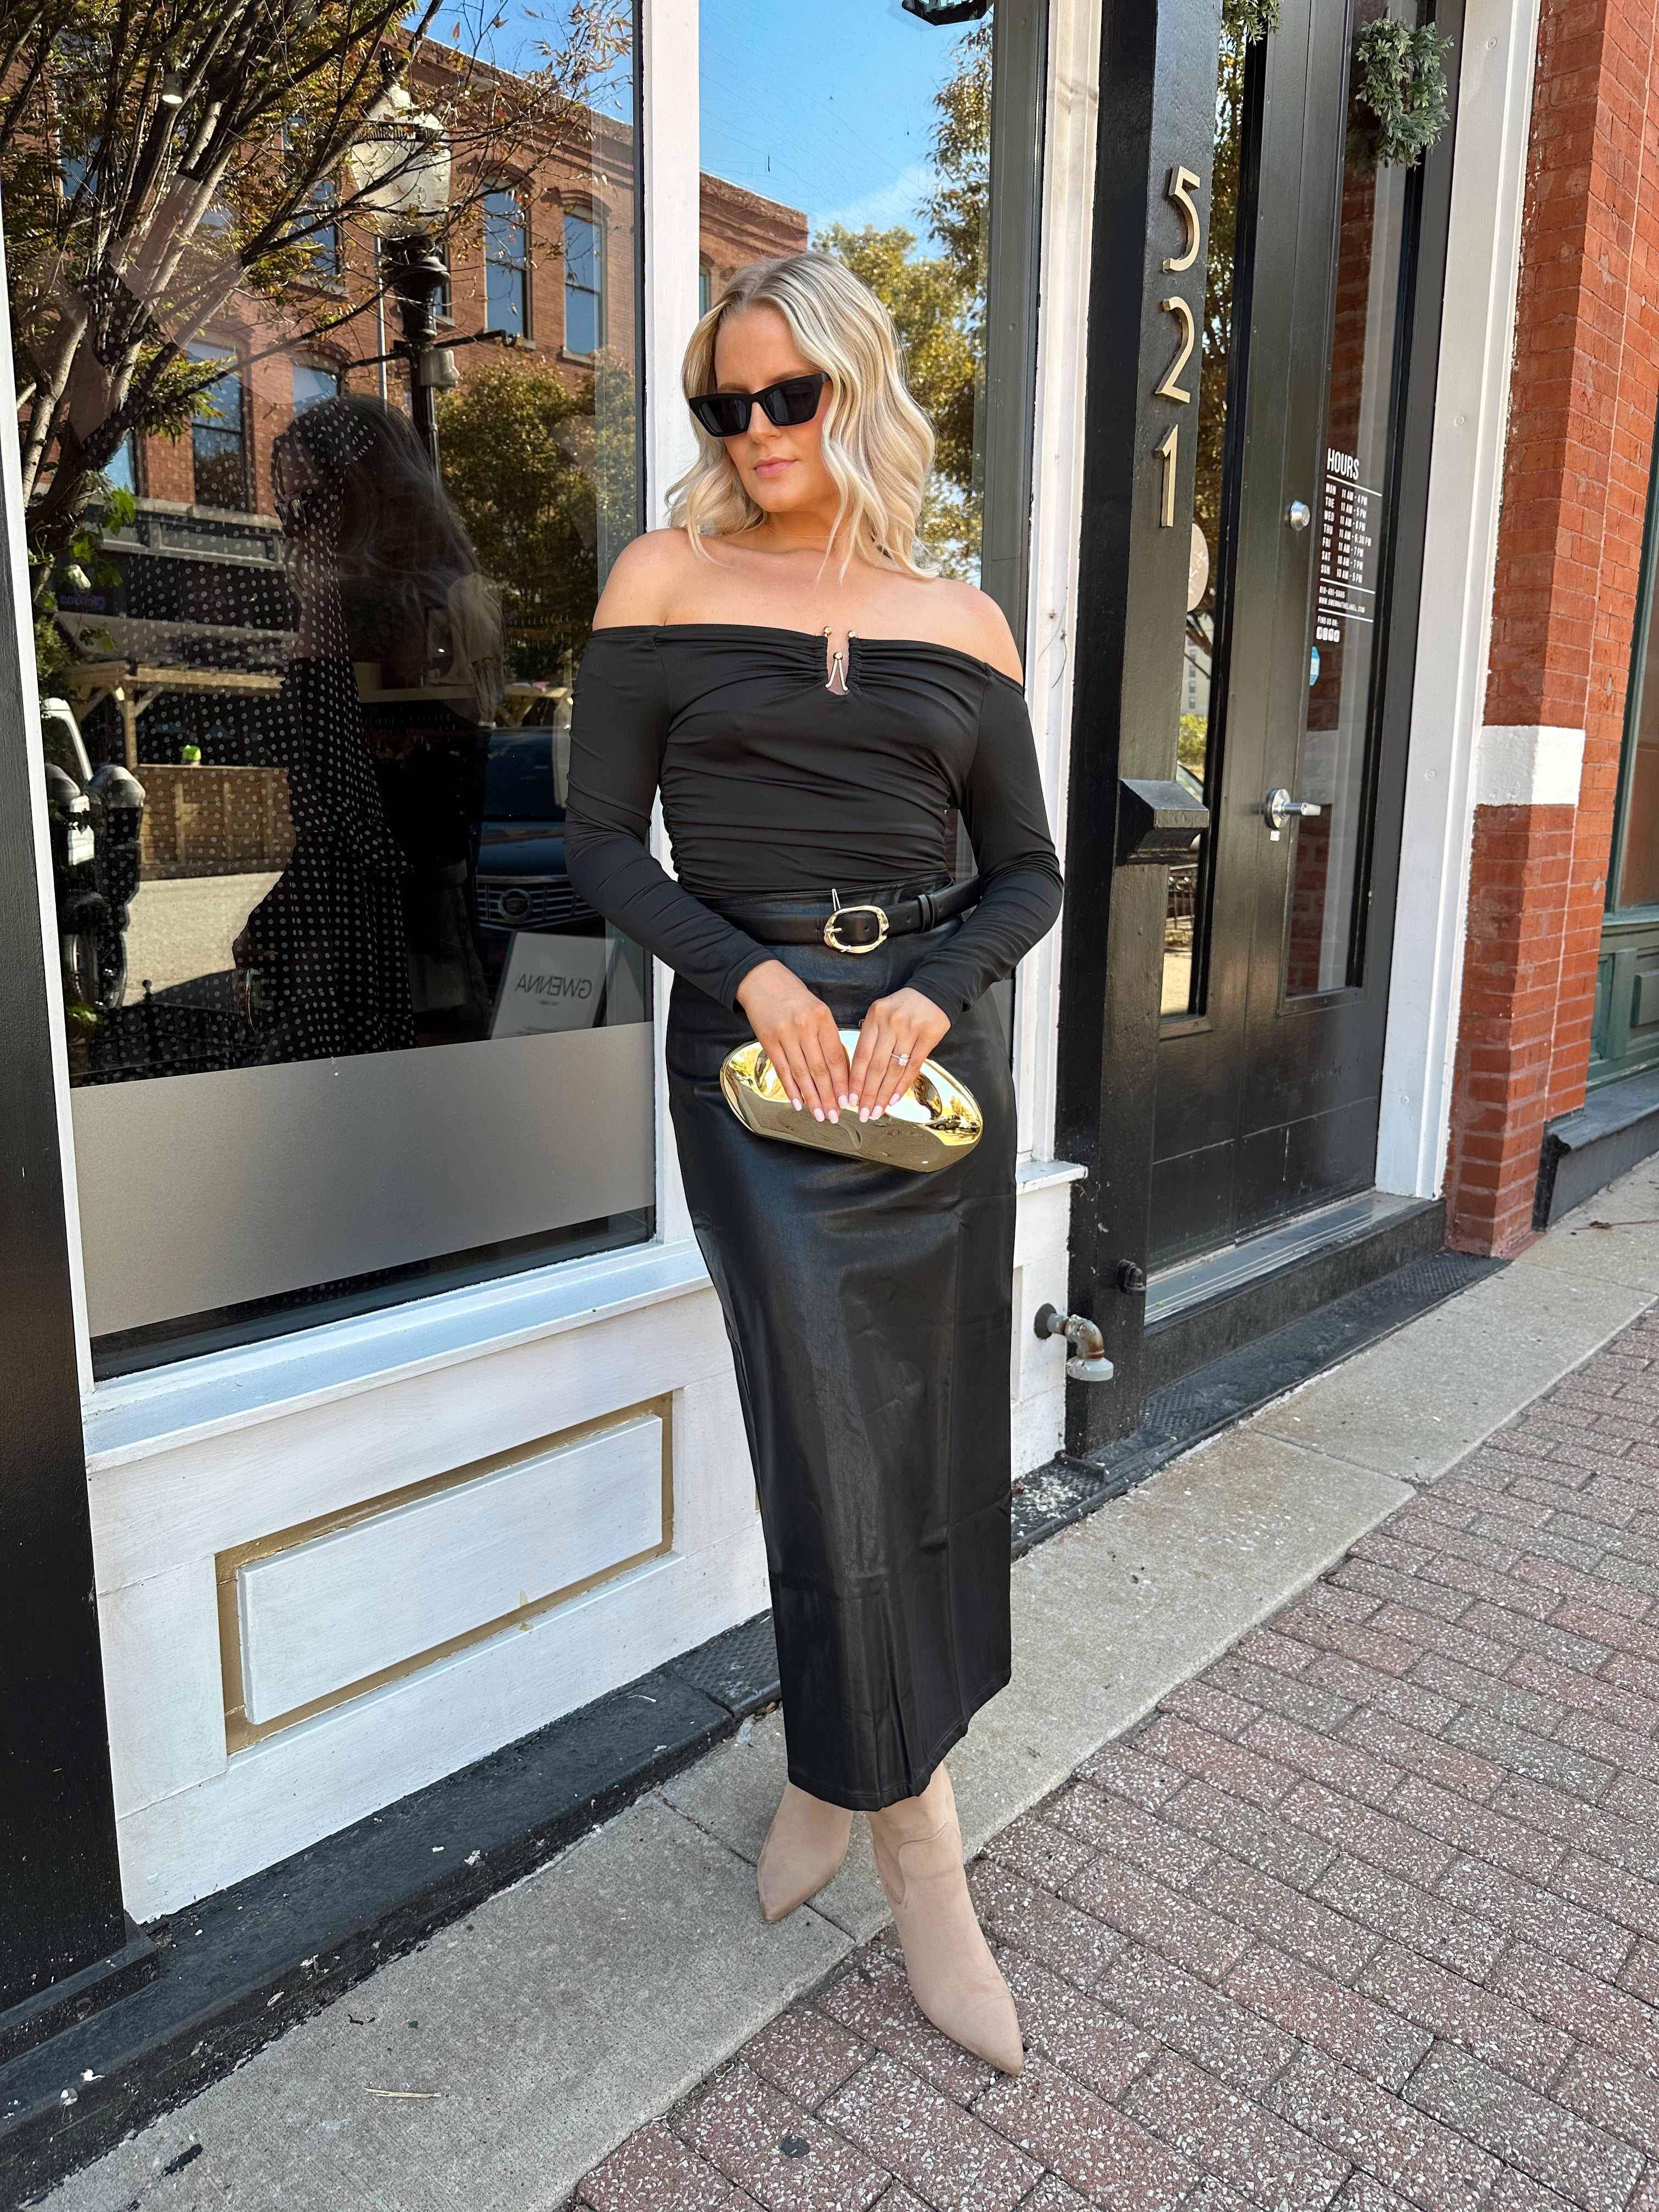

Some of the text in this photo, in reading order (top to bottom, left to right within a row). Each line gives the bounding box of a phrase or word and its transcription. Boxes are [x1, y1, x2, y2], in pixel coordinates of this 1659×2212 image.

[1155, 166, 1200, 527] 521
[1327, 448, 1359, 480] HOURS
[1325, 483, 1336, 495] MON
[1347, 490, 1354, 501] AM
[1325, 496, 1335, 508] TUE
[1346, 504, 1353, 514] AM
[1324, 510, 1335, 522] WED
[1345, 517, 1352, 527] AM
[1324, 523, 1333, 535] THU
[1344, 530, 1351, 540] AM
[1322, 537, 1331, 548] FRI
[1343, 543, 1350, 554] AM
[1322, 550, 1331, 561] SAT
[1342, 556, 1350, 567] AM
[1321, 564, 1330, 575] SUN
[1342, 570, 1349, 580] AM
[1318, 616, 1327, 624] FIND
